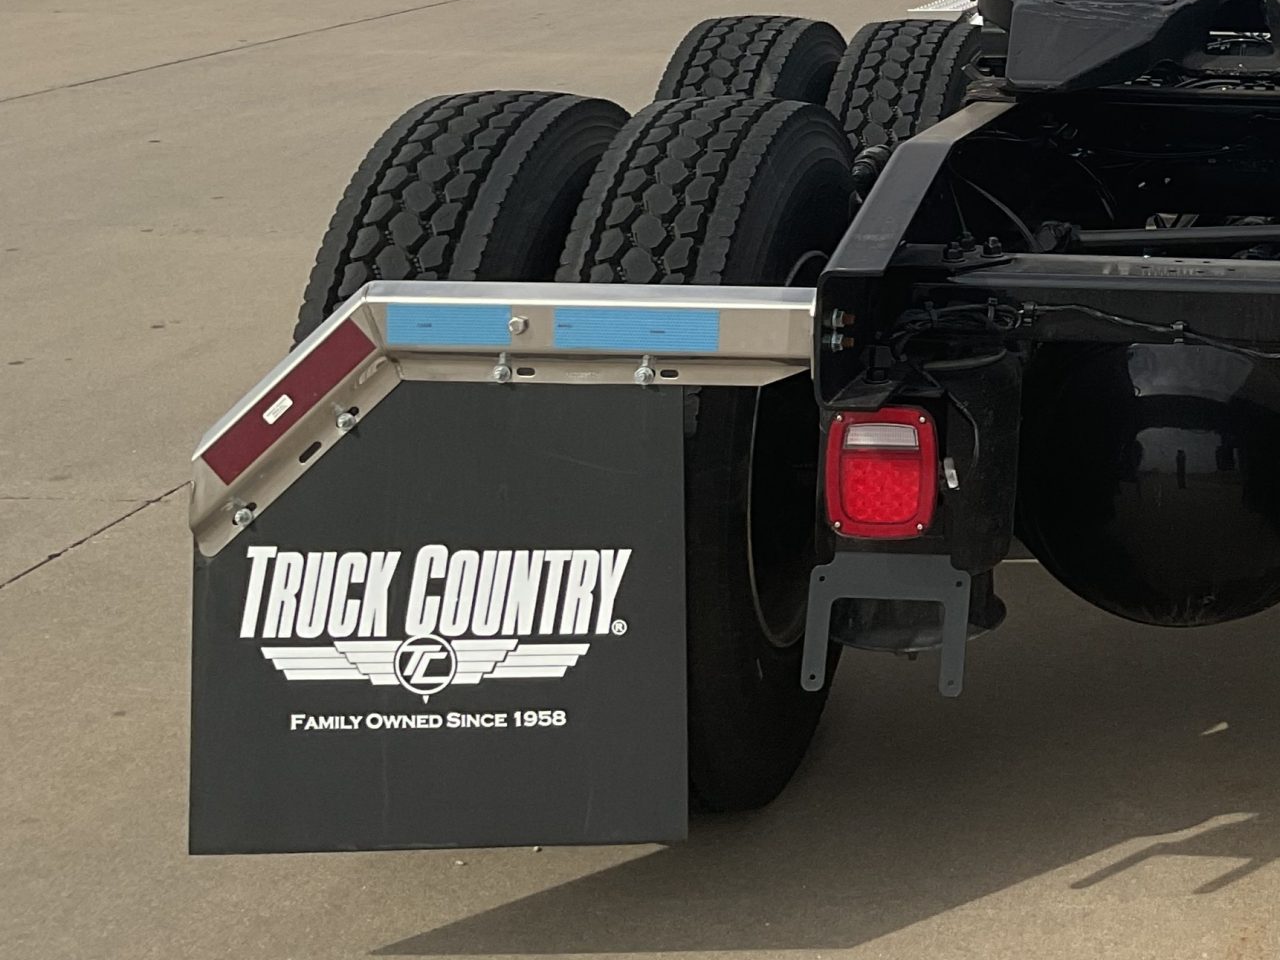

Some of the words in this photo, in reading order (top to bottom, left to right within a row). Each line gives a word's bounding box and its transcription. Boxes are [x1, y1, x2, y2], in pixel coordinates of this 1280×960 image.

[240, 546, 401, 638] TRUCK
[405, 544, 632, 637] COUNTRY
[291, 713, 363, 730] FAMILY
[366, 713, 443, 730] OWNED
[446, 711, 508, 729] SINCE
[513, 710, 567, 728] 1958
